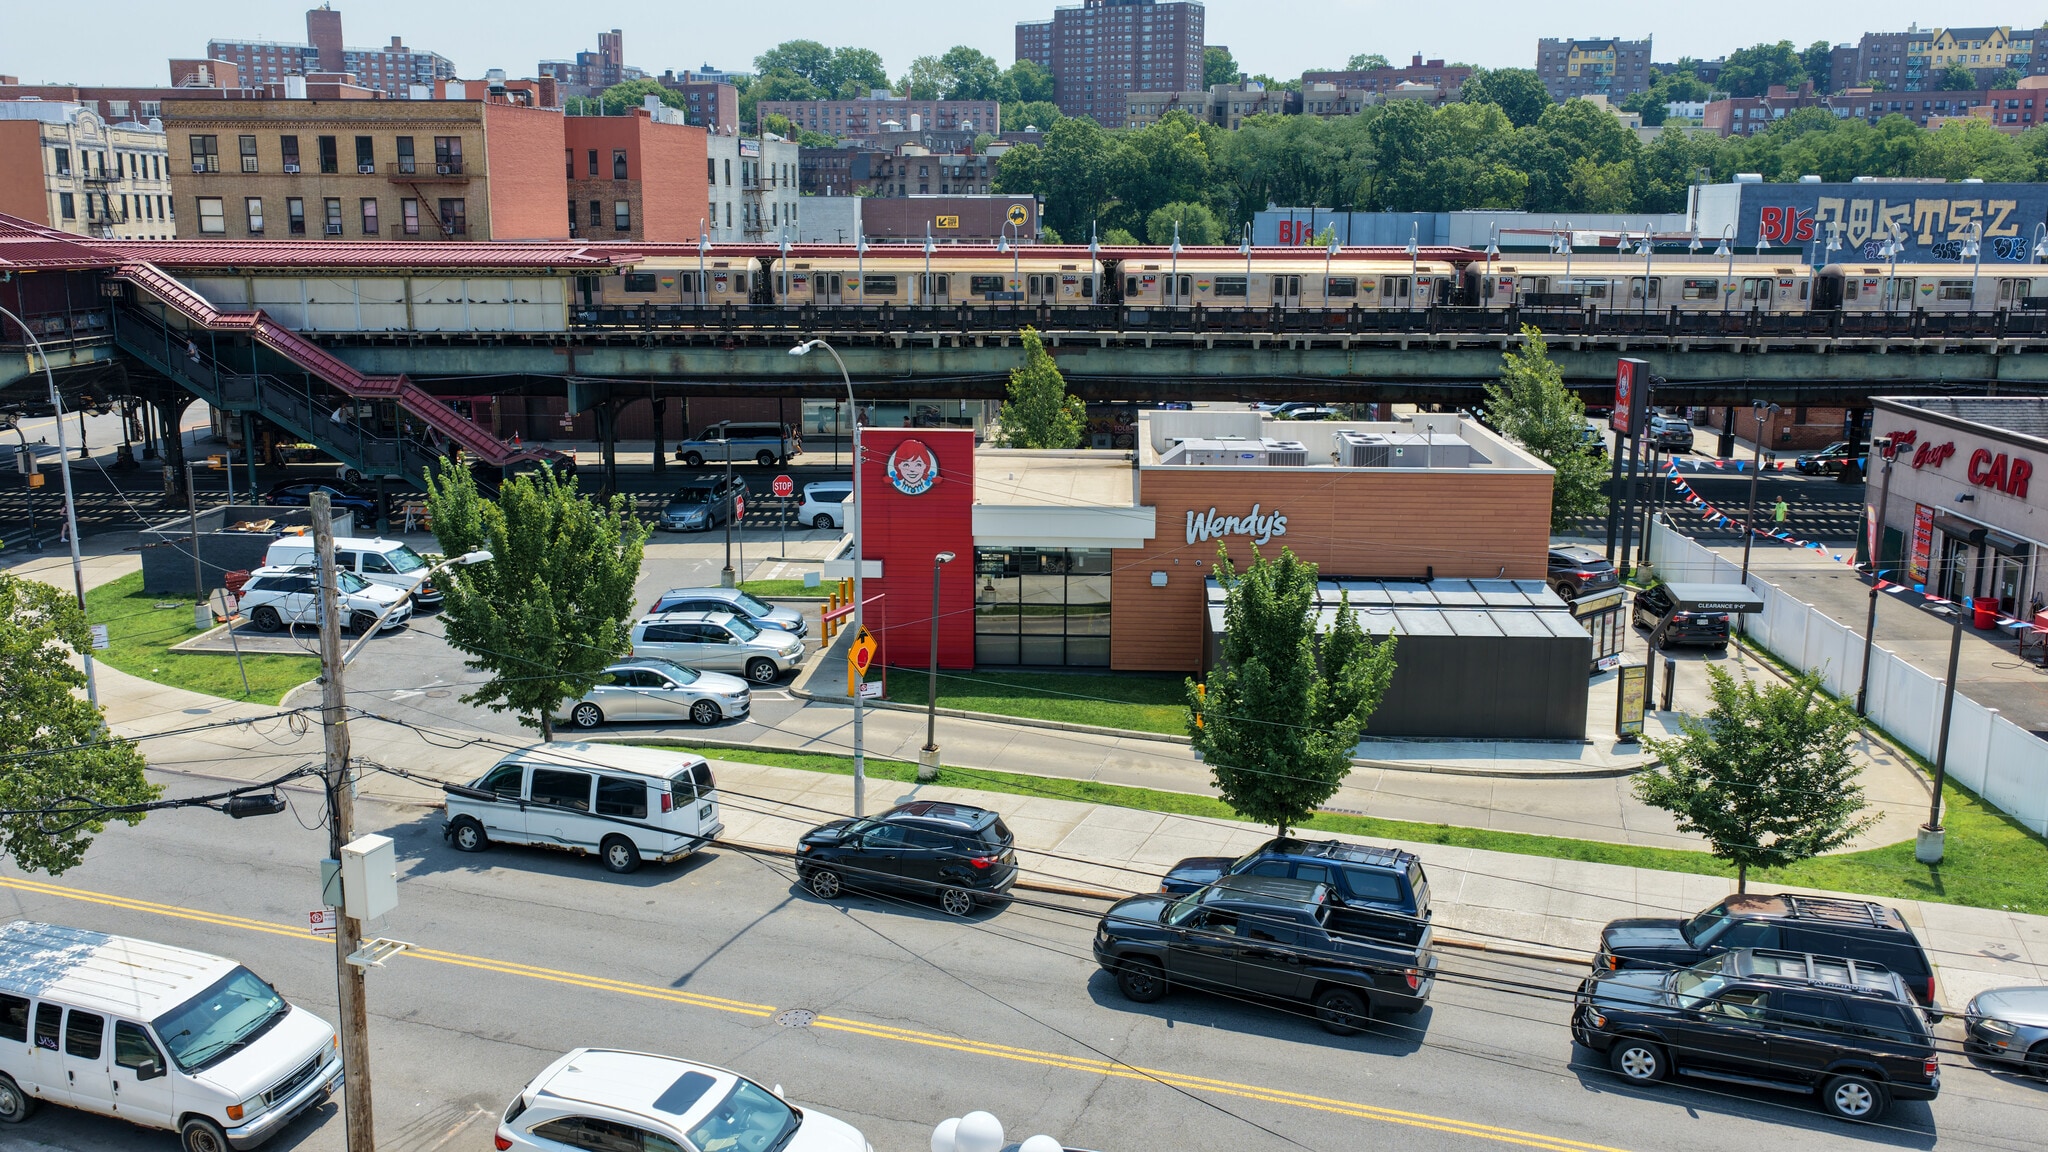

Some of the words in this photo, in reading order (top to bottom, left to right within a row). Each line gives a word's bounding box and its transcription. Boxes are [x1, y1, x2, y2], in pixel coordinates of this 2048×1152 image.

[1279, 220, 1313, 246] BJ's
[1760, 206, 1815, 245] BJ's
[774, 482, 792, 490] STOP
[1967, 448, 2033, 499] CAR
[1186, 503, 1288, 545] Wendy's
